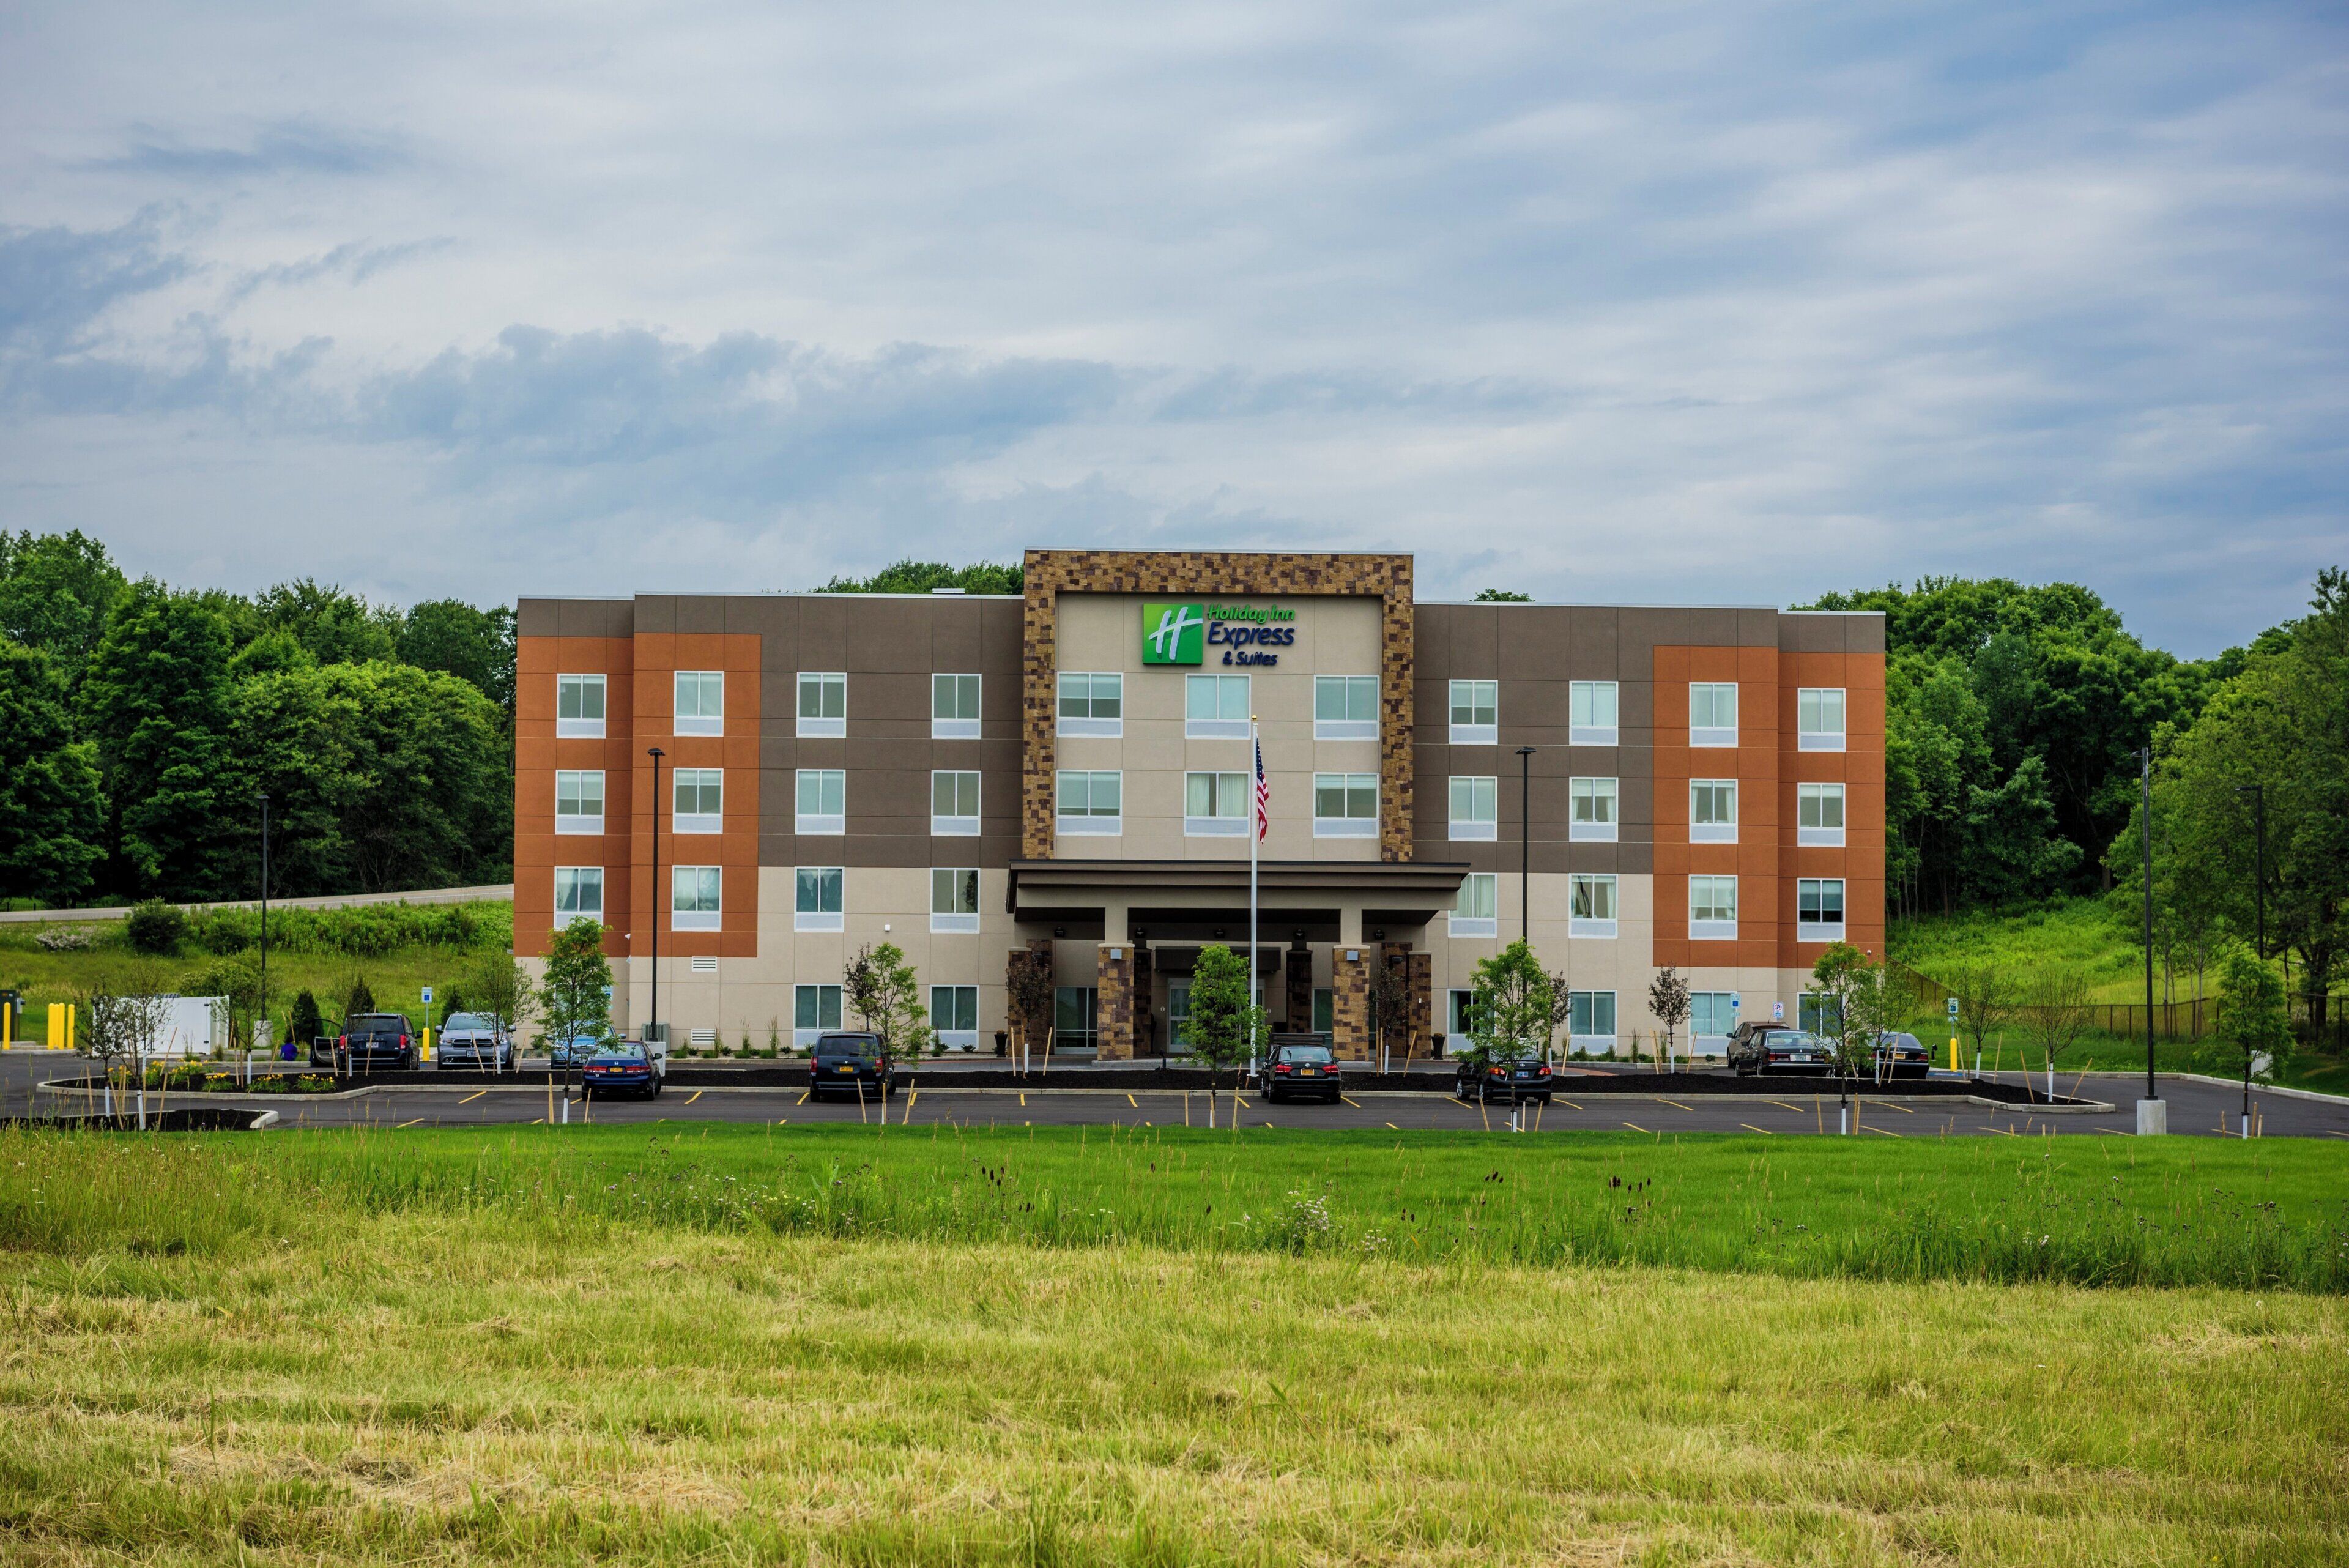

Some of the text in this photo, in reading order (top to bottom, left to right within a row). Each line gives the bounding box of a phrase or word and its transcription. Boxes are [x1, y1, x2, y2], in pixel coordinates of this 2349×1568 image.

[1208, 604, 1295, 624] Holiday Inn
[1208, 622, 1296, 650] Express
[1223, 651, 1278, 666] & Suites
